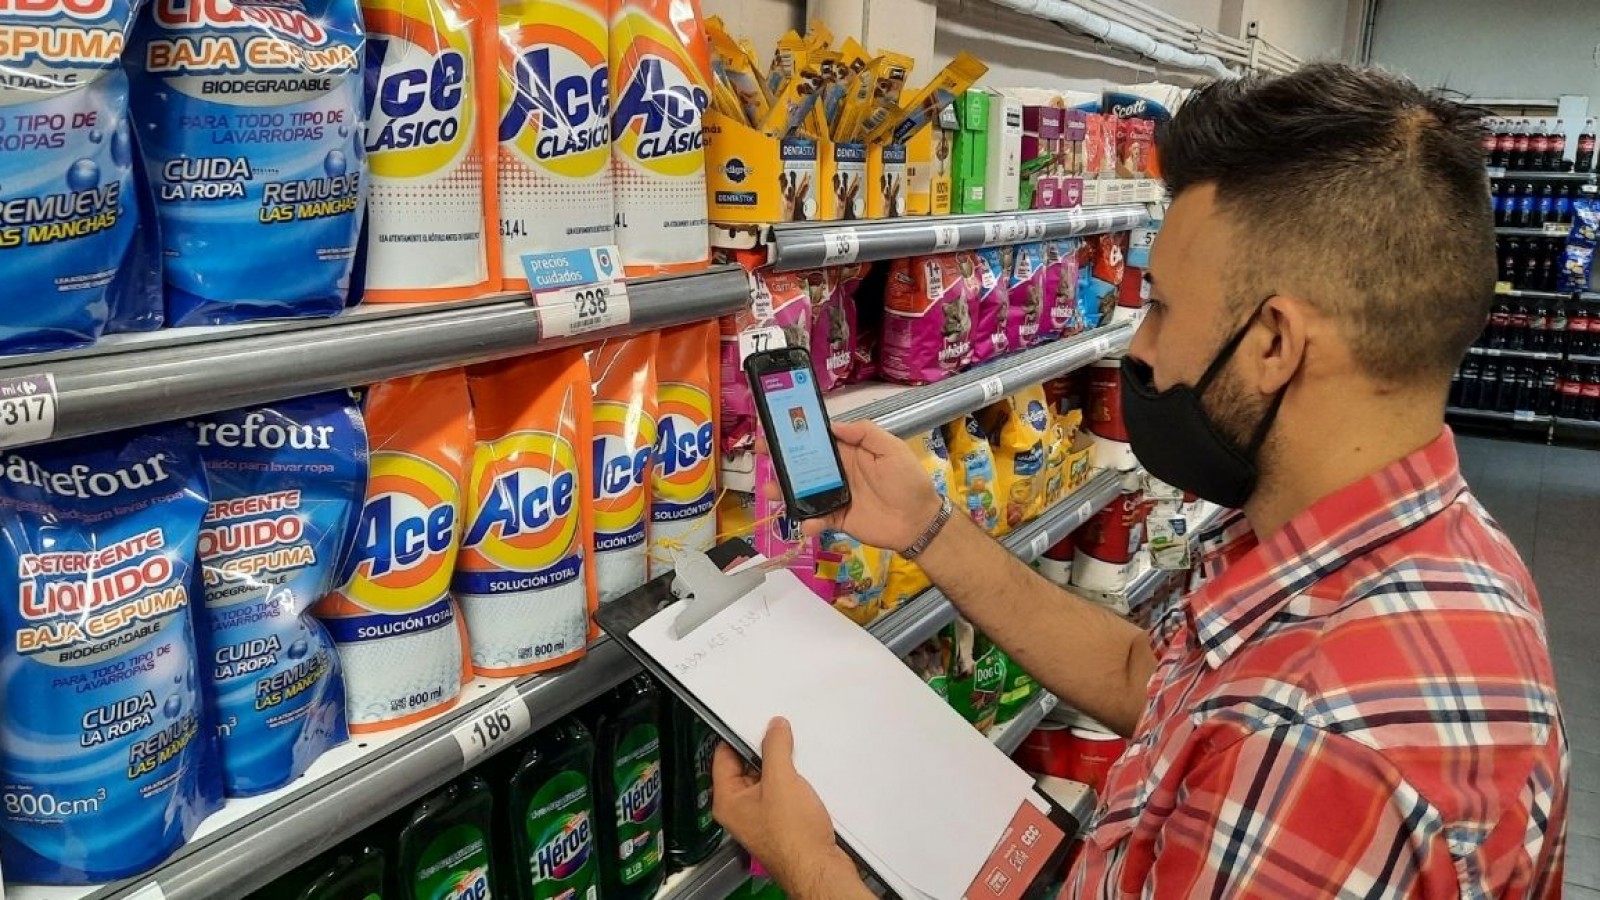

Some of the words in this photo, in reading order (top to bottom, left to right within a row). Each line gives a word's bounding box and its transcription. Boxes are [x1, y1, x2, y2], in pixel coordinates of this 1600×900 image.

[148, 38, 238, 69] BAJA
[202, 78, 331, 94] BIODEGRADABLE
[14, 113, 65, 132] TIPO
[72, 112, 97, 129] DE
[238, 113, 285, 128] TODO
[291, 111, 323, 125] TIPO
[326, 110, 343, 124] DE
[1112, 99, 1147, 120] Scott
[0, 133, 66, 152] OPAS
[211, 126, 323, 145] LAVARROPAS
[535, 122, 609, 159] CLÁSICO
[164, 156, 251, 181] CUIDA
[0, 181, 119, 224] EMUEVE
[161, 183, 184, 199] LA
[190, 182, 245, 199] ROPA
[28, 209, 116, 243] MANCHAS
[260, 205, 294, 222] LAS
[530, 256, 570, 274] precios
[536, 270, 584, 286] cuidados
[3, 397, 46, 426] 317
[188, 413, 334, 450] refour
[652, 416, 713, 476] Ace
[0, 453, 169, 498] arrefour
[304, 464, 335, 474] ropa
[462, 471, 573, 546] Ace
[654, 504, 698, 520] SOLUCIÓN
[343, 496, 455, 577] Ace
[22, 530, 162, 576] DETERGENTE
[22, 556, 171, 618] LIQUIDO
[490, 574, 548, 592] SOLUCIÓN
[549, 567, 576, 583] TOTAL
[18, 622, 81, 649] BAJA
[87, 588, 187, 634] ESPUMA
[357, 617, 424, 638] SOLUCIÓN
[59, 621, 161, 663] BIODEGRADABLE
[156, 643, 171, 659] DE
[215, 634, 281, 664] CUIDA
[535, 643, 553, 656] 800
[554, 640, 565, 653] ml
[76, 659, 155, 693] LAVARROPAS
[215, 667, 234, 679] LA
[236, 654, 278, 676] ROPA
[254, 690, 282, 712] LAS
[409, 692, 430, 708] 800
[430, 686, 442, 700] ml
[82, 691, 156, 729] CUIDA
[80, 729, 103, 747] LA
[107, 712, 153, 740] ROPA
[128, 755, 156, 779] LAS
[621, 770, 659, 822] Héroe
[538, 818, 589, 878] Héroe
